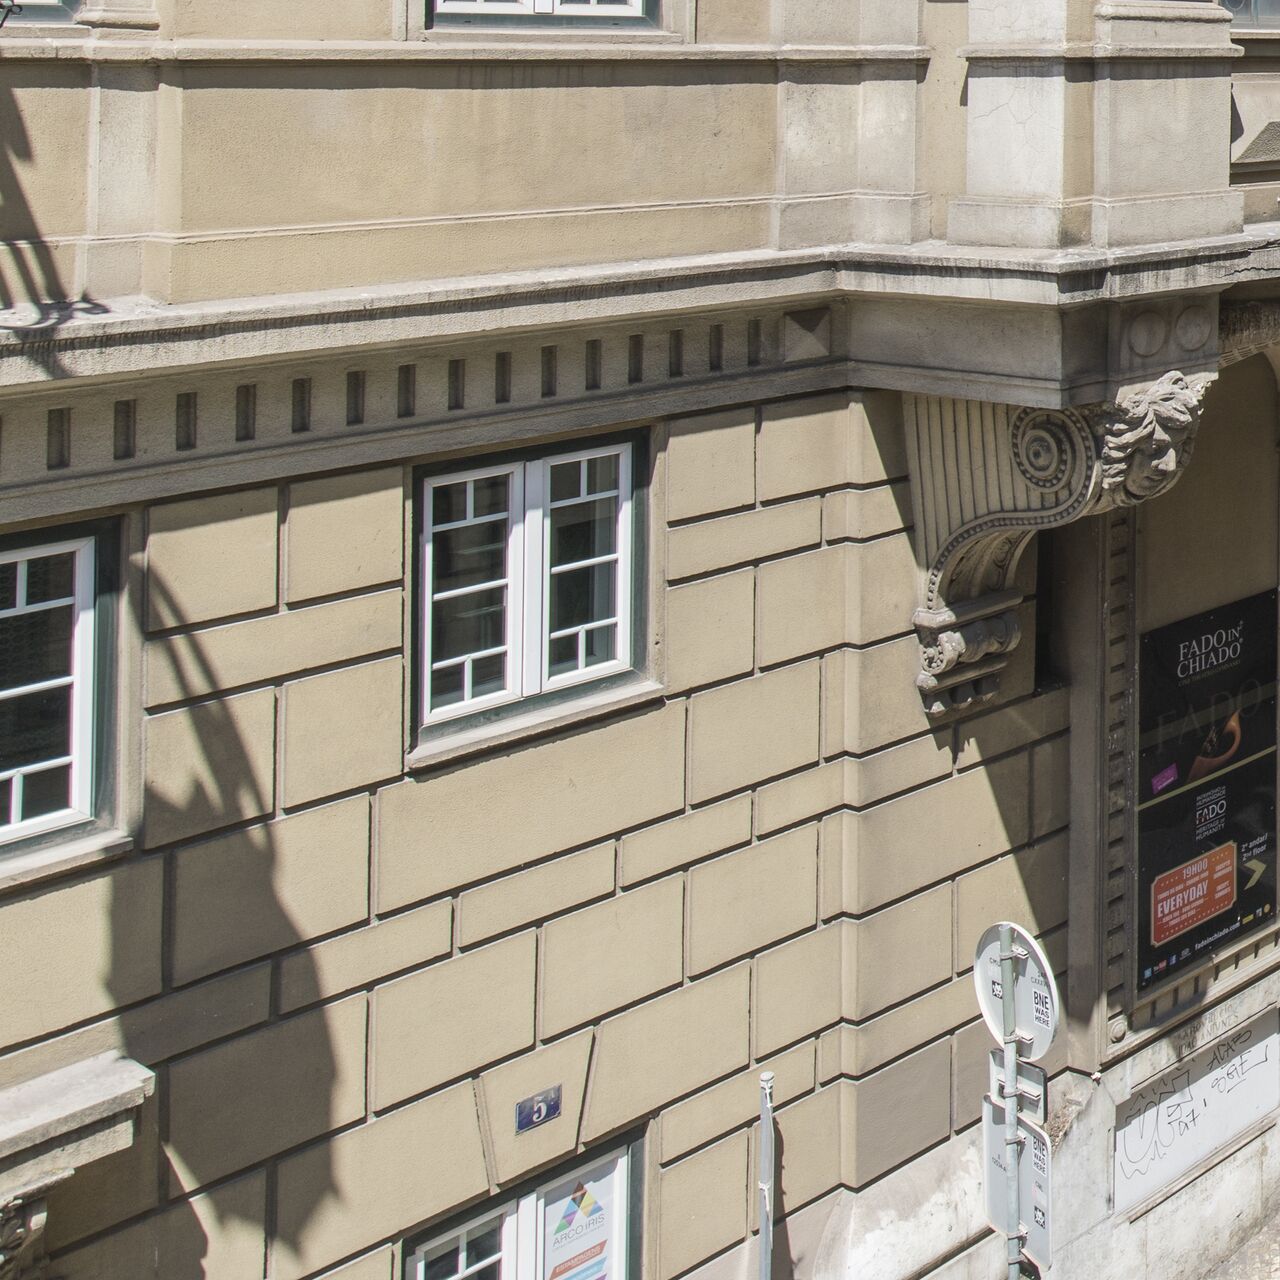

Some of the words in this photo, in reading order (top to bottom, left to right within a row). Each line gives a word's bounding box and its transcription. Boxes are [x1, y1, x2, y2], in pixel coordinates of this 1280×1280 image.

[1179, 629, 1226, 661] FADO
[1227, 626, 1240, 642] IN
[1177, 642, 1241, 678] CHIADO
[1195, 800, 1227, 824] FADO
[1252, 843, 1267, 856] floor
[1183, 858, 1208, 879] 19H00
[1157, 880, 1209, 918] EVERYDAY
[1033, 990, 1049, 1011] BNE
[1034, 1006, 1050, 1019] WAS
[1034, 1014, 1050, 1028] HERE
[532, 1095, 547, 1122] 5
[1032, 1135, 1046, 1158] BNE
[1033, 1150, 1046, 1166] WAS
[1033, 1161, 1046, 1175] HERE
[553, 1224, 584, 1248] ARCO
[585, 1213, 606, 1230] IRIS
